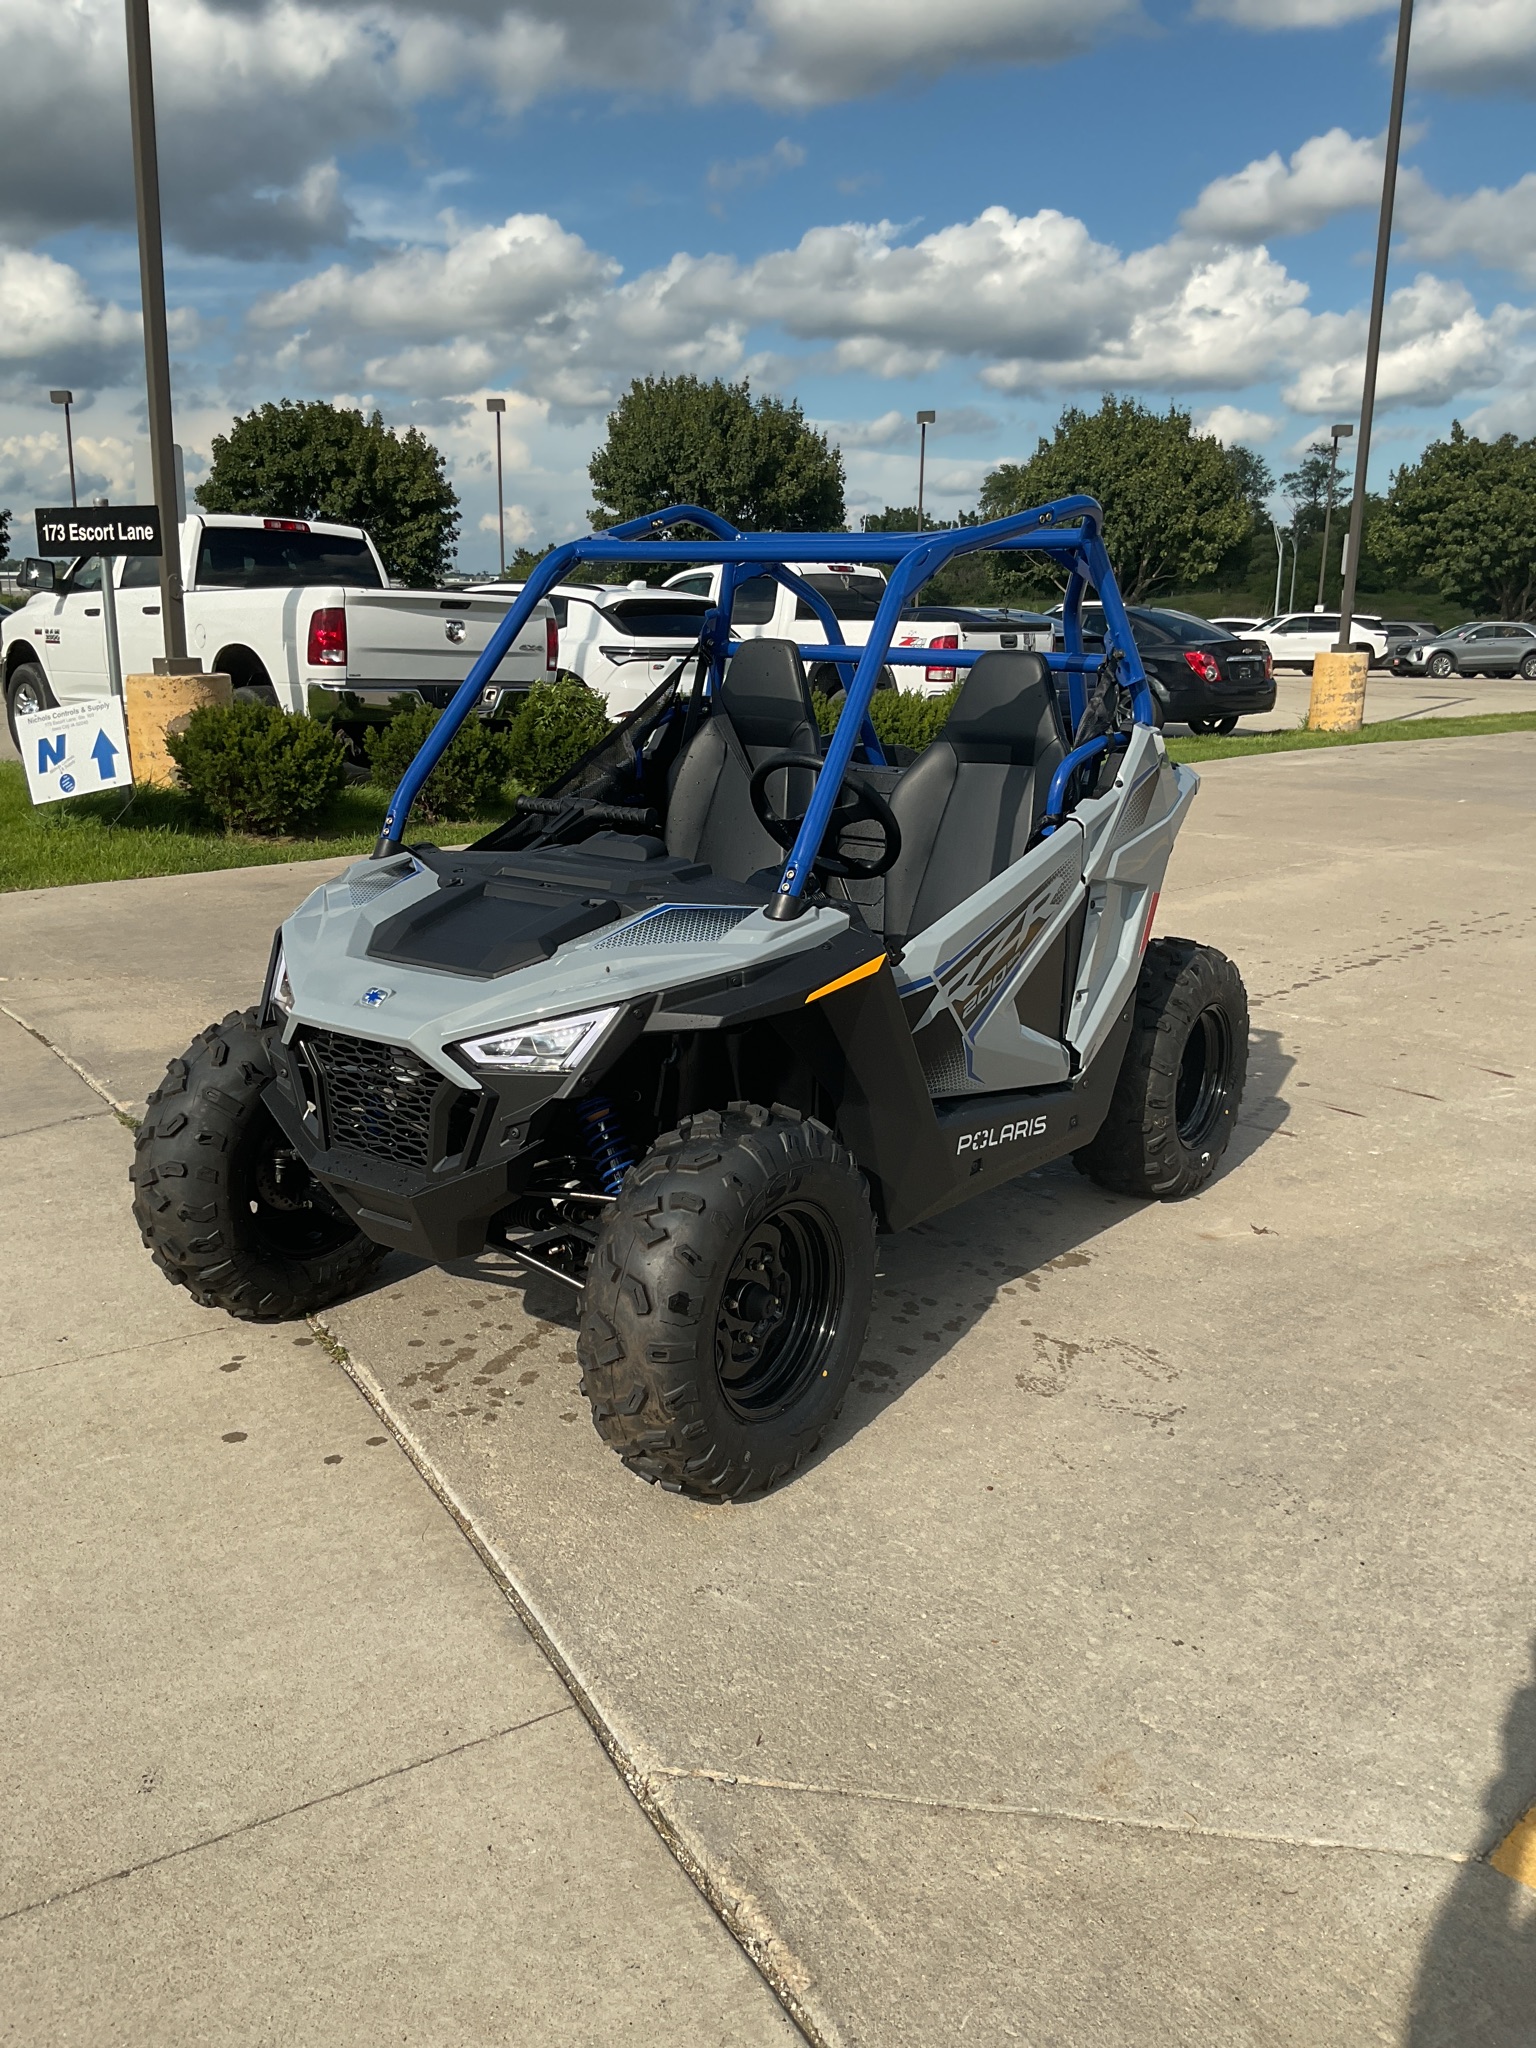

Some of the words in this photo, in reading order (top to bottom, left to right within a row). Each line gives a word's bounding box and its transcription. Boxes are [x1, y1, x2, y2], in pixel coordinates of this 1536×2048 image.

[43, 523, 66, 542] 173
[68, 523, 115, 541] Escort
[117, 522, 154, 541] Lane
[28, 714, 51, 725] Nichols
[52, 709, 79, 719] Controls
[87, 703, 110, 712] Supply
[38, 733, 66, 774] N
[912, 875, 1064, 1034] RZR
[962, 964, 1007, 1019] 200
[956, 1115, 1047, 1155] POLARIS
